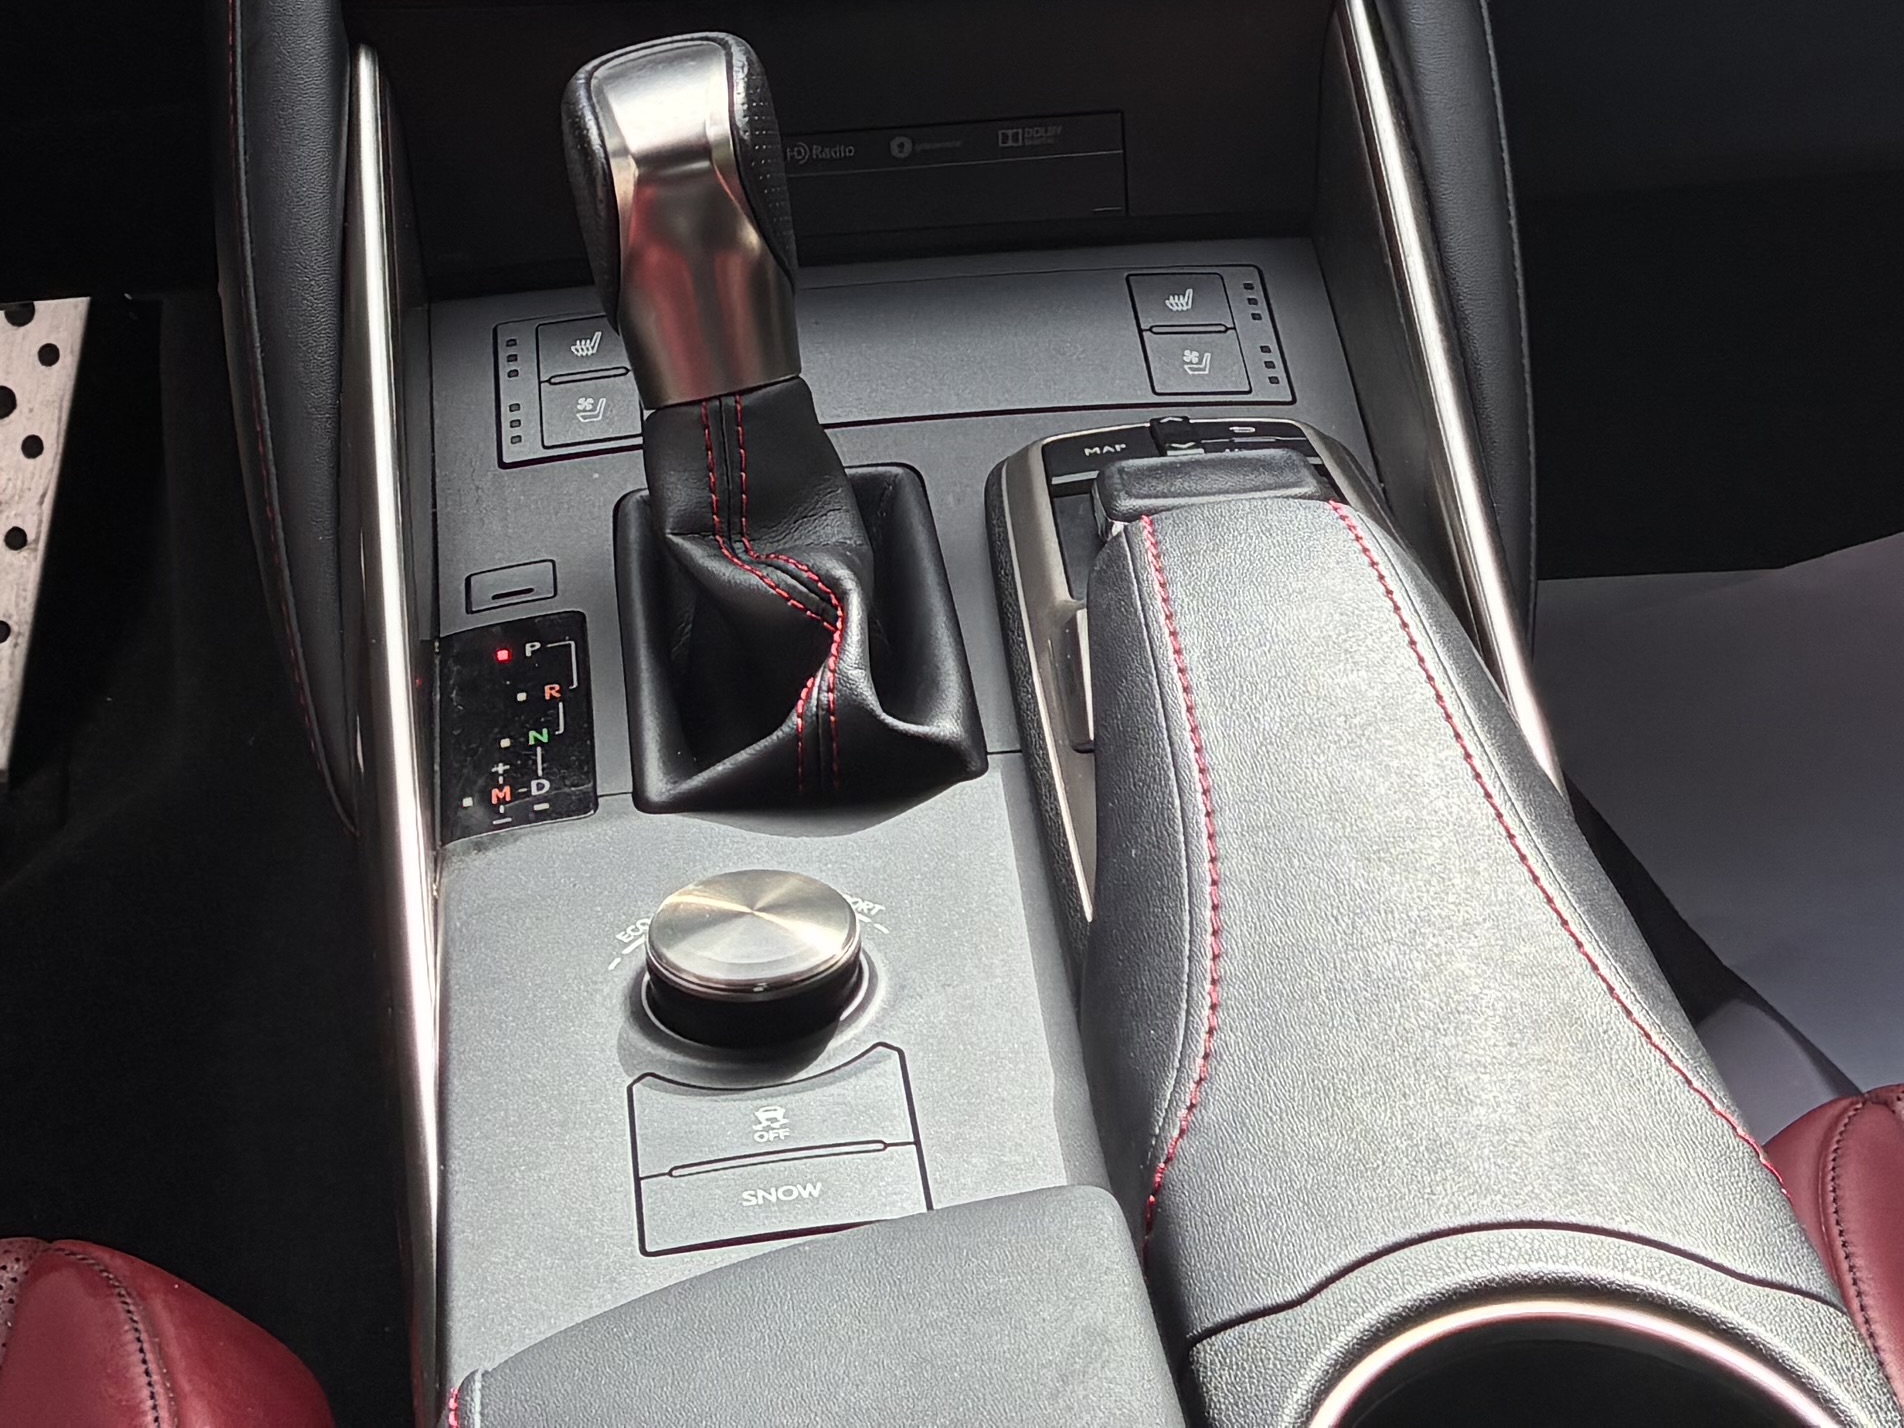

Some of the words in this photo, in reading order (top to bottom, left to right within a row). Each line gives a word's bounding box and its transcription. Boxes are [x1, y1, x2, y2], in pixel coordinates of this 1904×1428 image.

[812, 144, 856, 160] Radio
[1084, 441, 1127, 457] MAP
[524, 641, 542, 658] P
[544, 683, 562, 701] R
[528, 727, 550, 746] N
[491, 785, 512, 805] M
[530, 779, 551, 796] D
[848, 893, 887, 917] ORT
[615, 917, 651, 943] ECO
[752, 1125, 790, 1143] OFF
[740, 1181, 823, 1208] SNOW
